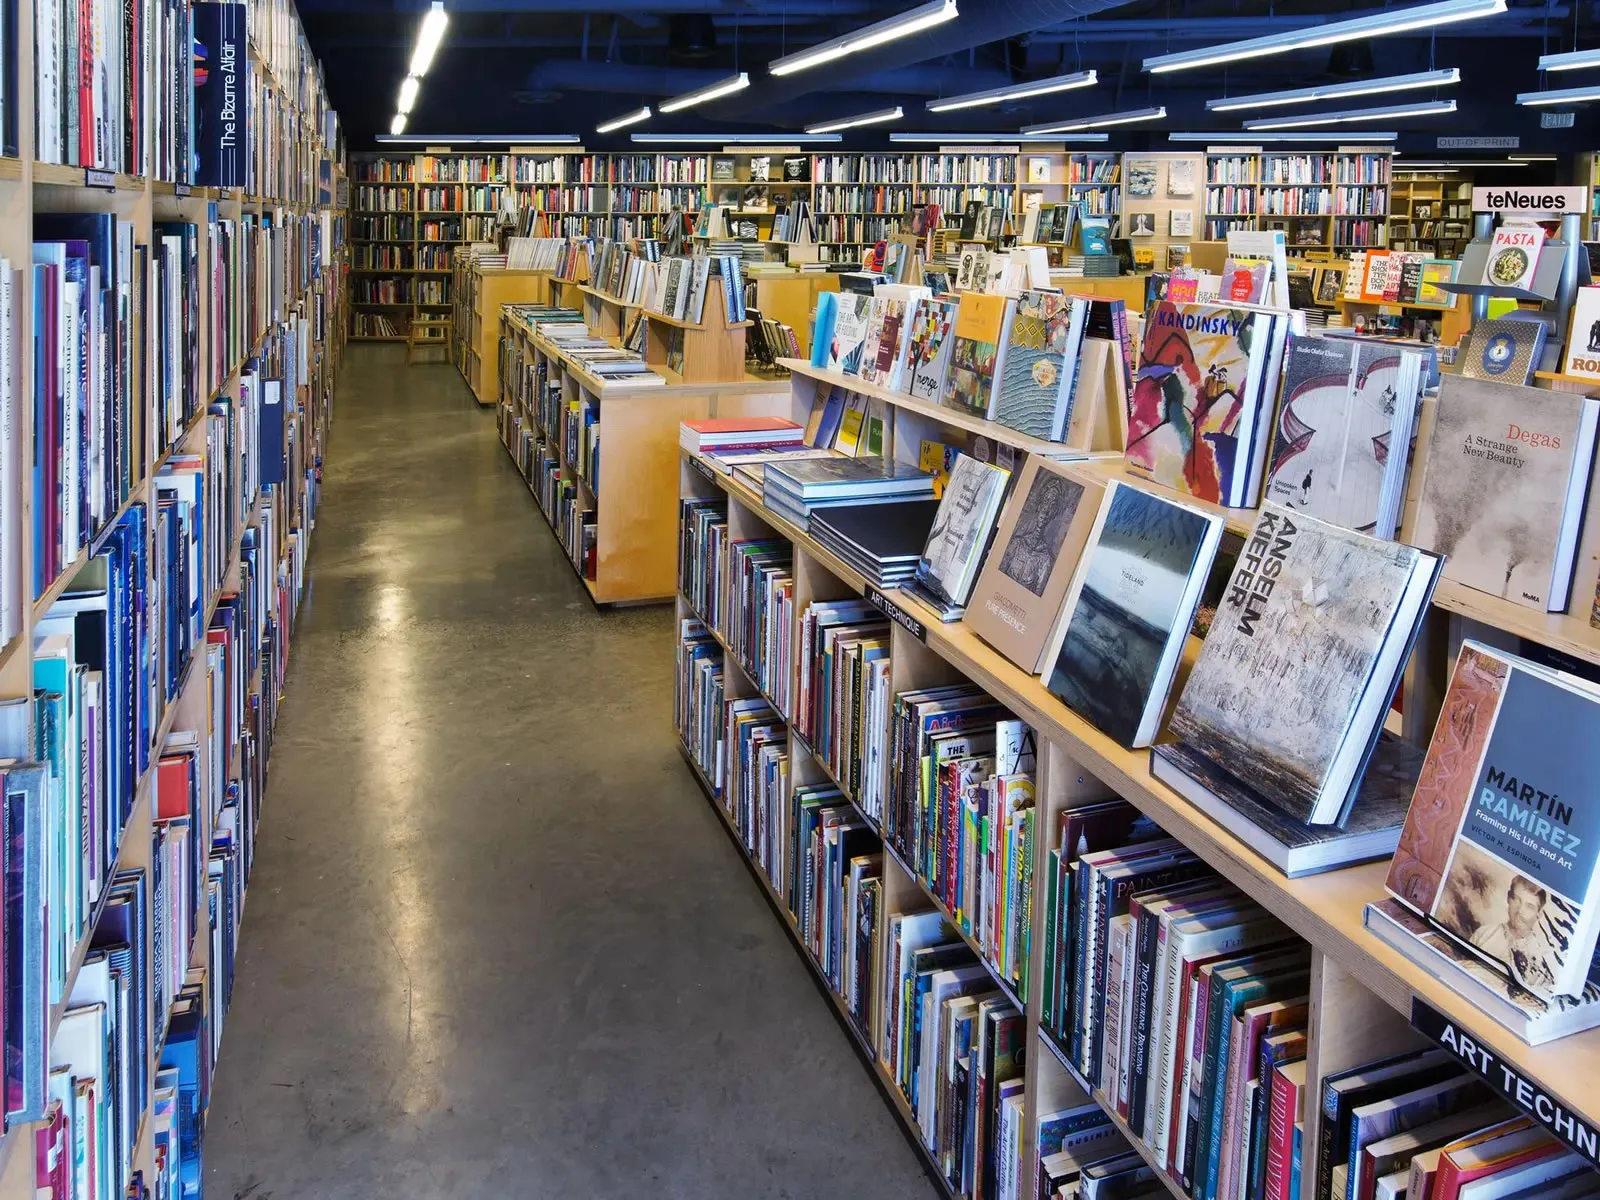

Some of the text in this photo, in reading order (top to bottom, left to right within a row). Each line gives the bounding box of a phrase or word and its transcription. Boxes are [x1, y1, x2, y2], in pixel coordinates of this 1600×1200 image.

[221, 41, 236, 149] The Bizarre Affair
[1487, 191, 1566, 208] teNeues
[1496, 233, 1535, 246] PASTA
[1159, 311, 1240, 337] KANDINSKY
[917, 374, 939, 397] merge
[1465, 434, 1518, 454] A Strange
[1506, 424, 1561, 449] Degas
[1463, 445, 1525, 468] New Beauty
[1274, 486, 1291, 496] Spaces
[1275, 479, 1297, 491] Unspoken
[1226, 511, 1280, 607] KIEFER
[1120, 570, 1144, 587] TIDELAND
[1237, 516, 1298, 637] ANSELM
[993, 592, 1027, 619] GIACOMETTI
[1522, 592, 1540, 603] MoMA
[871, 591, 920, 636] ART TECHNIQUE
[984, 600, 1028, 634] PURE PRESENCE
[853, 661, 861, 701] DRAWING
[947, 745, 965, 756] THE
[1486, 766, 1573, 826] MARTÍN
[1479, 787, 1581, 858] RAMÍREZ
[1475, 809, 1573, 871] Framing His Life and Art
[1024, 864, 1029, 875] TO
[1496, 840, 1505, 849] M.
[1506, 845, 1542, 871] ESPINOSA
[1077, 914, 1085, 951] Complete
[1096, 901, 1106, 986] PAINTABILITY
[1075, 953, 1083, 993] Stencilling
[1142, 963, 1150, 981] THE
[1222, 998, 1231, 1035] CREATIVE
[1136, 1032, 1146, 1074] BRONZING
[1157, 944, 1179, 1137] THE HANDBOOK OF PAINTED DECORATION
[1220, 1038, 1228, 1061] PAINT
[1216, 1062, 1226, 1097] FINISHES
[1259, 1053, 1268, 1083] Careers
[1440, 1024, 1600, 1166] ART TECHN
[1270, 1087, 1287, 1147] WRITE
[1212, 1133, 1221, 1159] HOME
[1324, 1129, 1332, 1145] The
